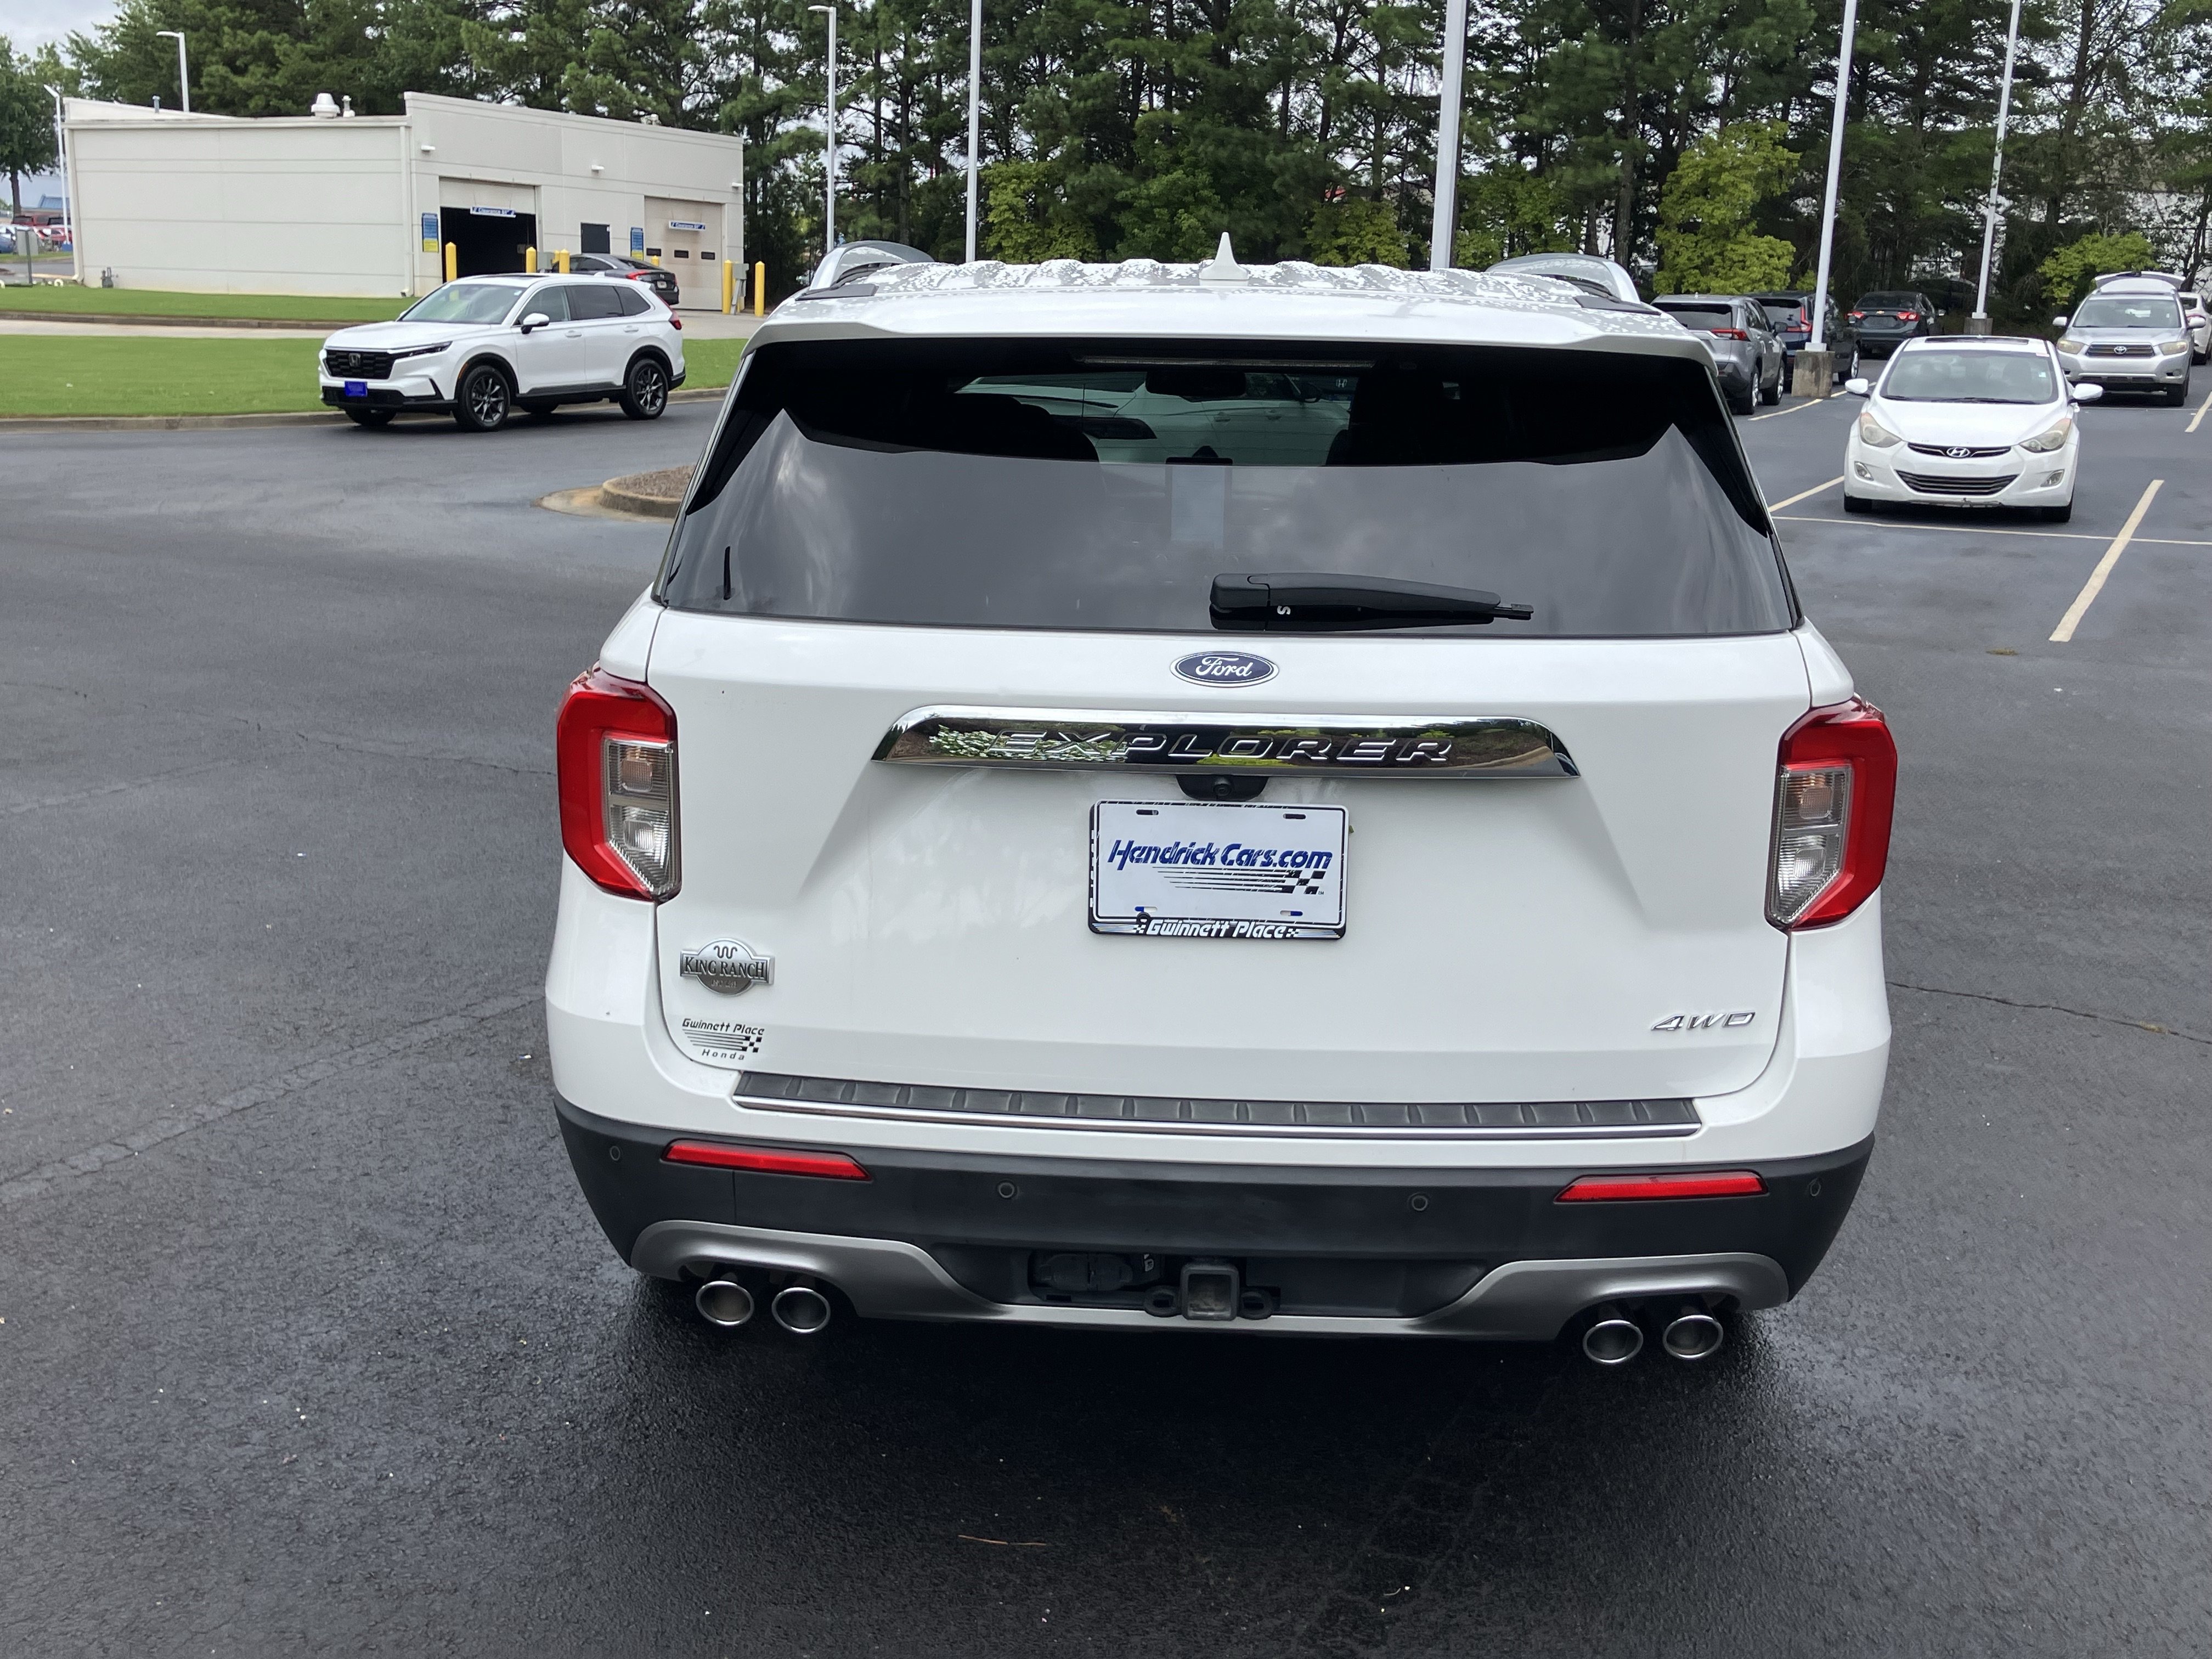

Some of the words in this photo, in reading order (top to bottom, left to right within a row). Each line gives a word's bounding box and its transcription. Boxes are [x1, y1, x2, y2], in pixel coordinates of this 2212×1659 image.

[1195, 656, 1255, 677] Ford
[988, 729, 1452, 761] EXPLORER
[1146, 919, 1229, 937] Gwinnett
[1232, 921, 1286, 939] Place
[684, 956, 716, 976] KING
[719, 961, 765, 979] RANCH
[682, 1018, 731, 1032] Gwinnett
[732, 1023, 765, 1036] Place
[1650, 1012, 1756, 1031] 4WD
[701, 1048, 745, 1060] Honda
